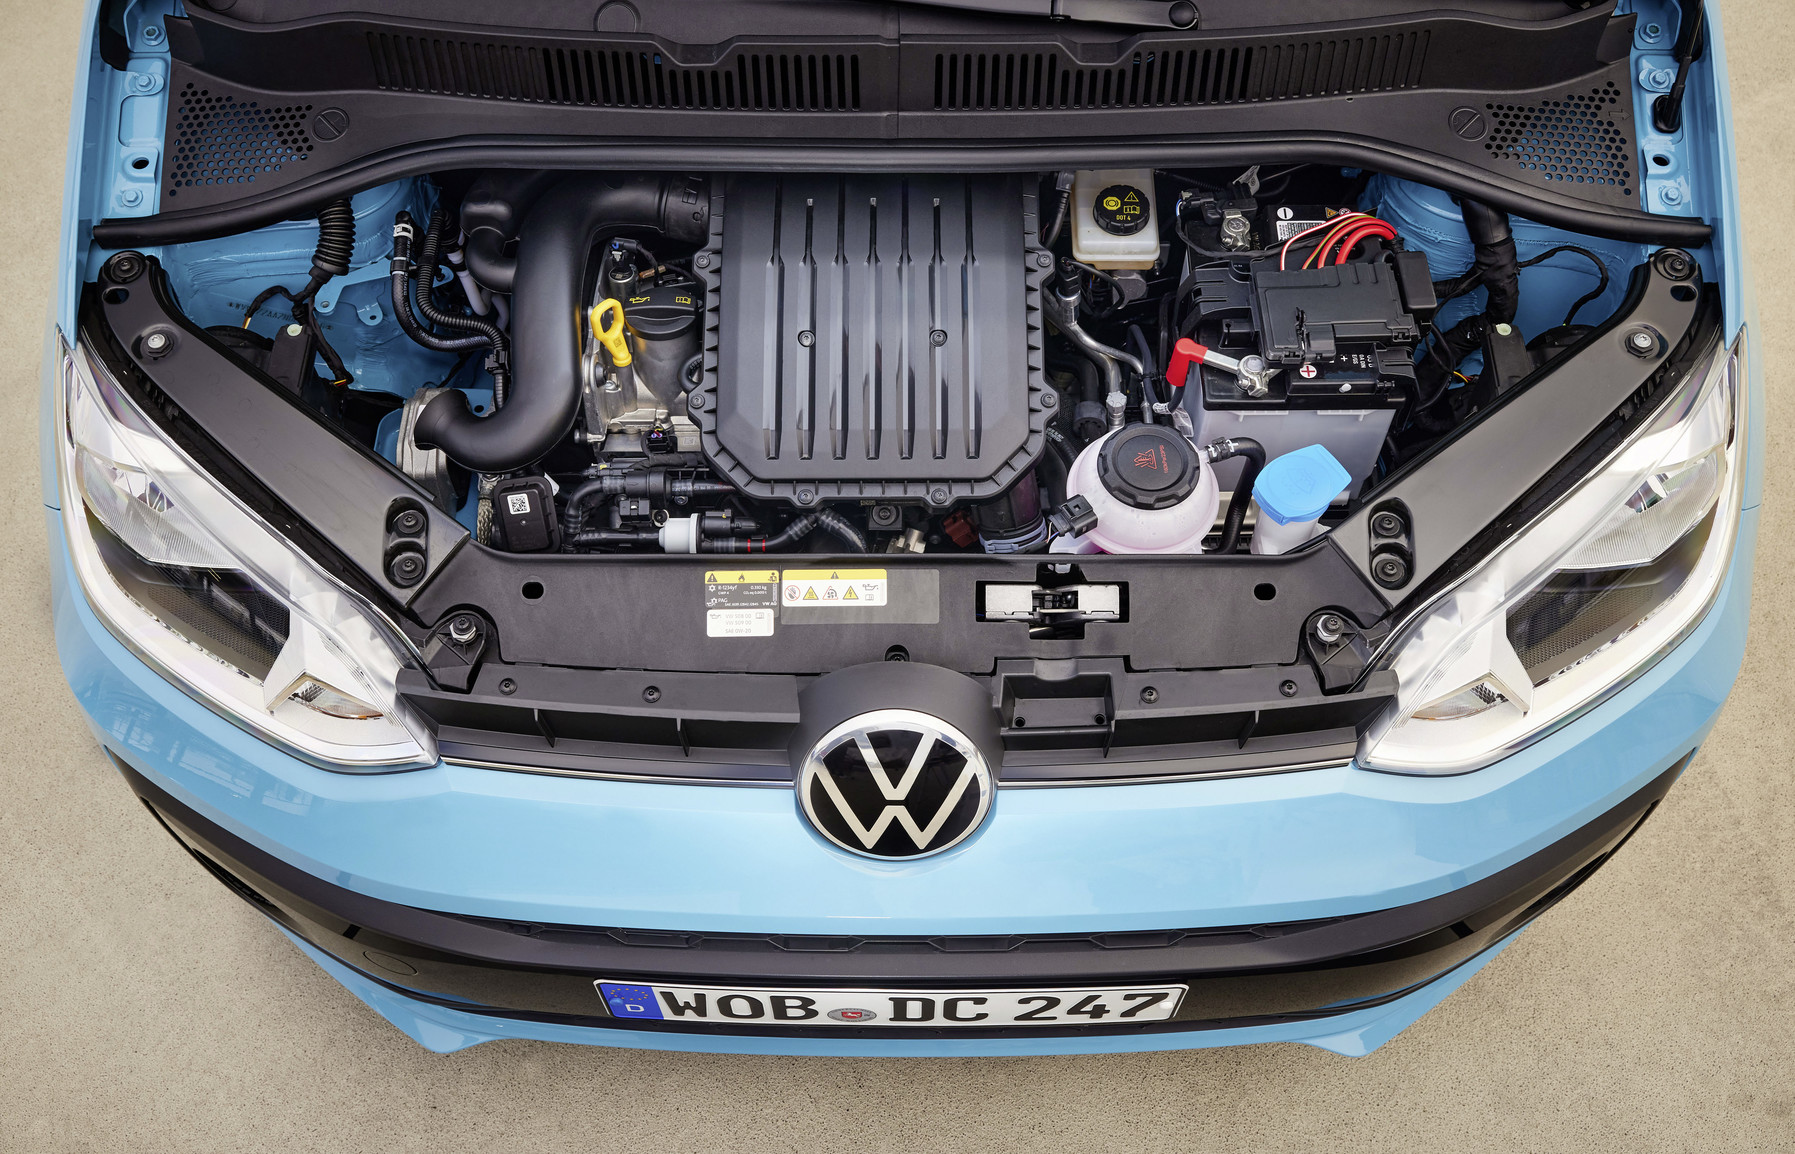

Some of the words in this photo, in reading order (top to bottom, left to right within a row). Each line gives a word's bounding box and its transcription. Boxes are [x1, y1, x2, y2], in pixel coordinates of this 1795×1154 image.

[808, 725, 982, 852] VW
[625, 1003, 645, 1012] D
[659, 990, 819, 1021] WOB
[888, 996, 989, 1022] DC
[1013, 992, 1170, 1022] 247
